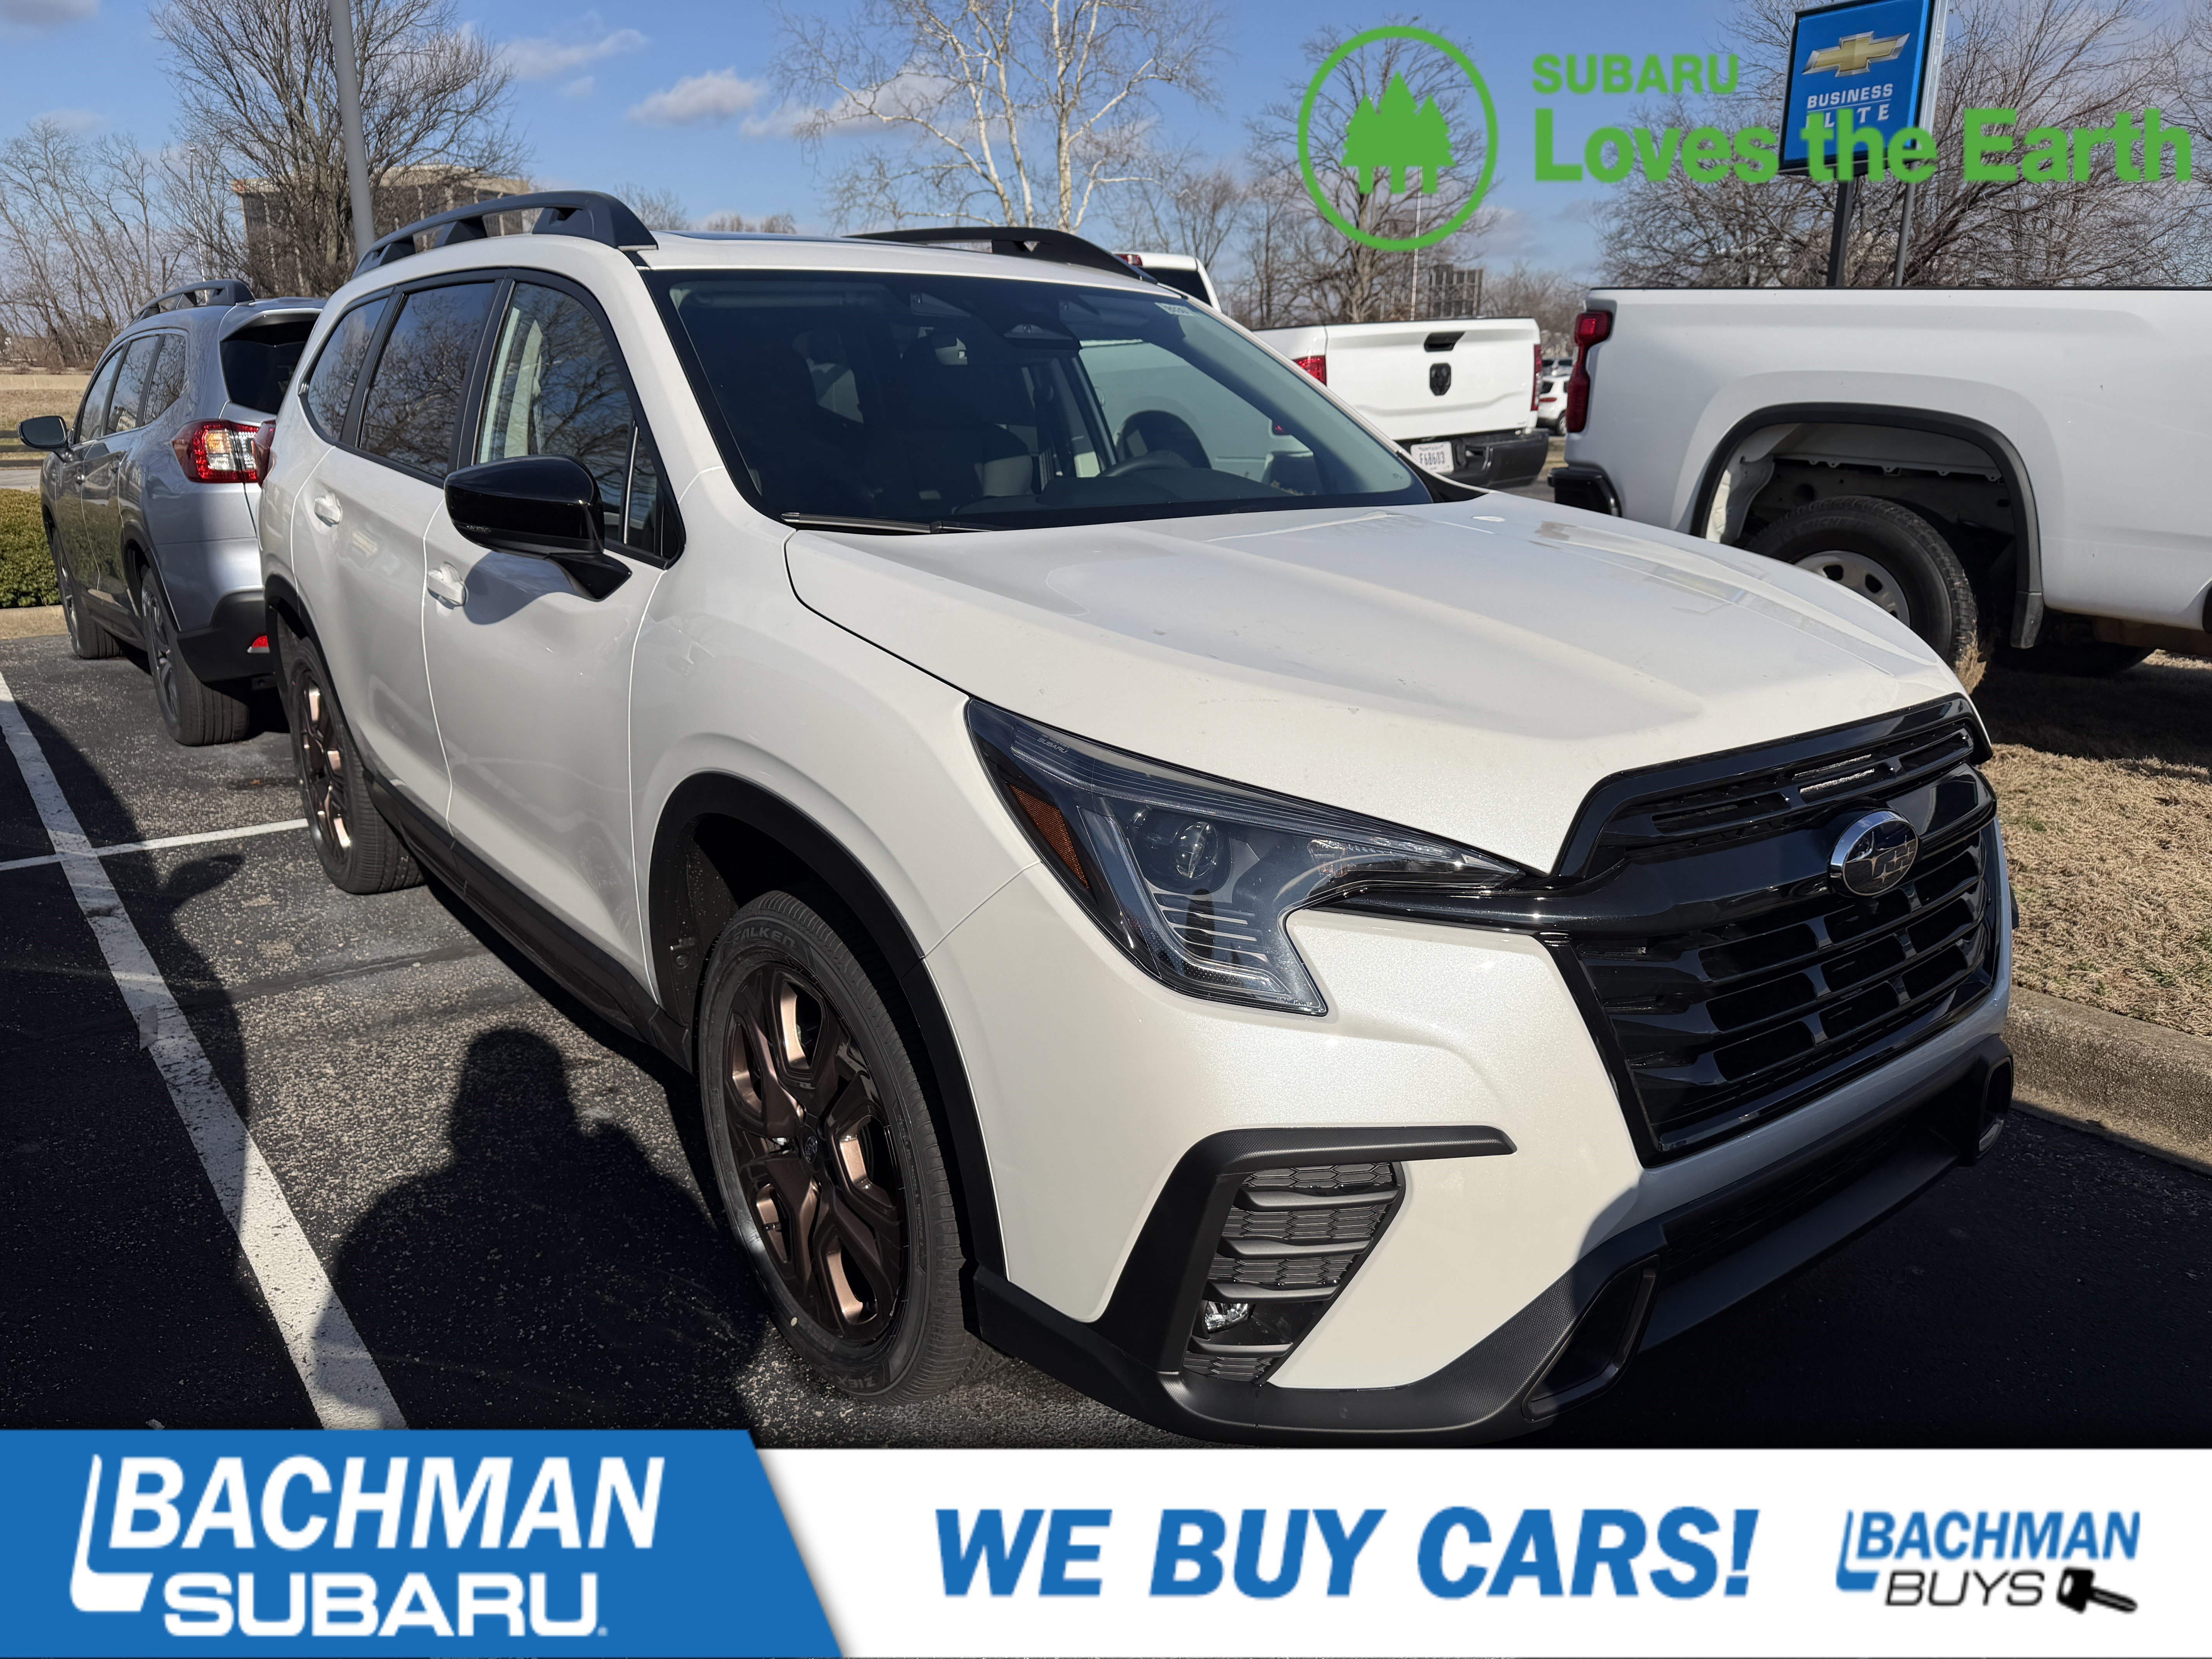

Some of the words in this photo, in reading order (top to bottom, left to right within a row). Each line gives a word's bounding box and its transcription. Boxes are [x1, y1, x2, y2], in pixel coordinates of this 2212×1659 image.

[1807, 83, 1893, 109] BUSINESS
[1805, 103, 1890, 129] LTE
[1037, 737, 1068, 753] SUBARU
[732, 927, 797, 948] FALKEN
